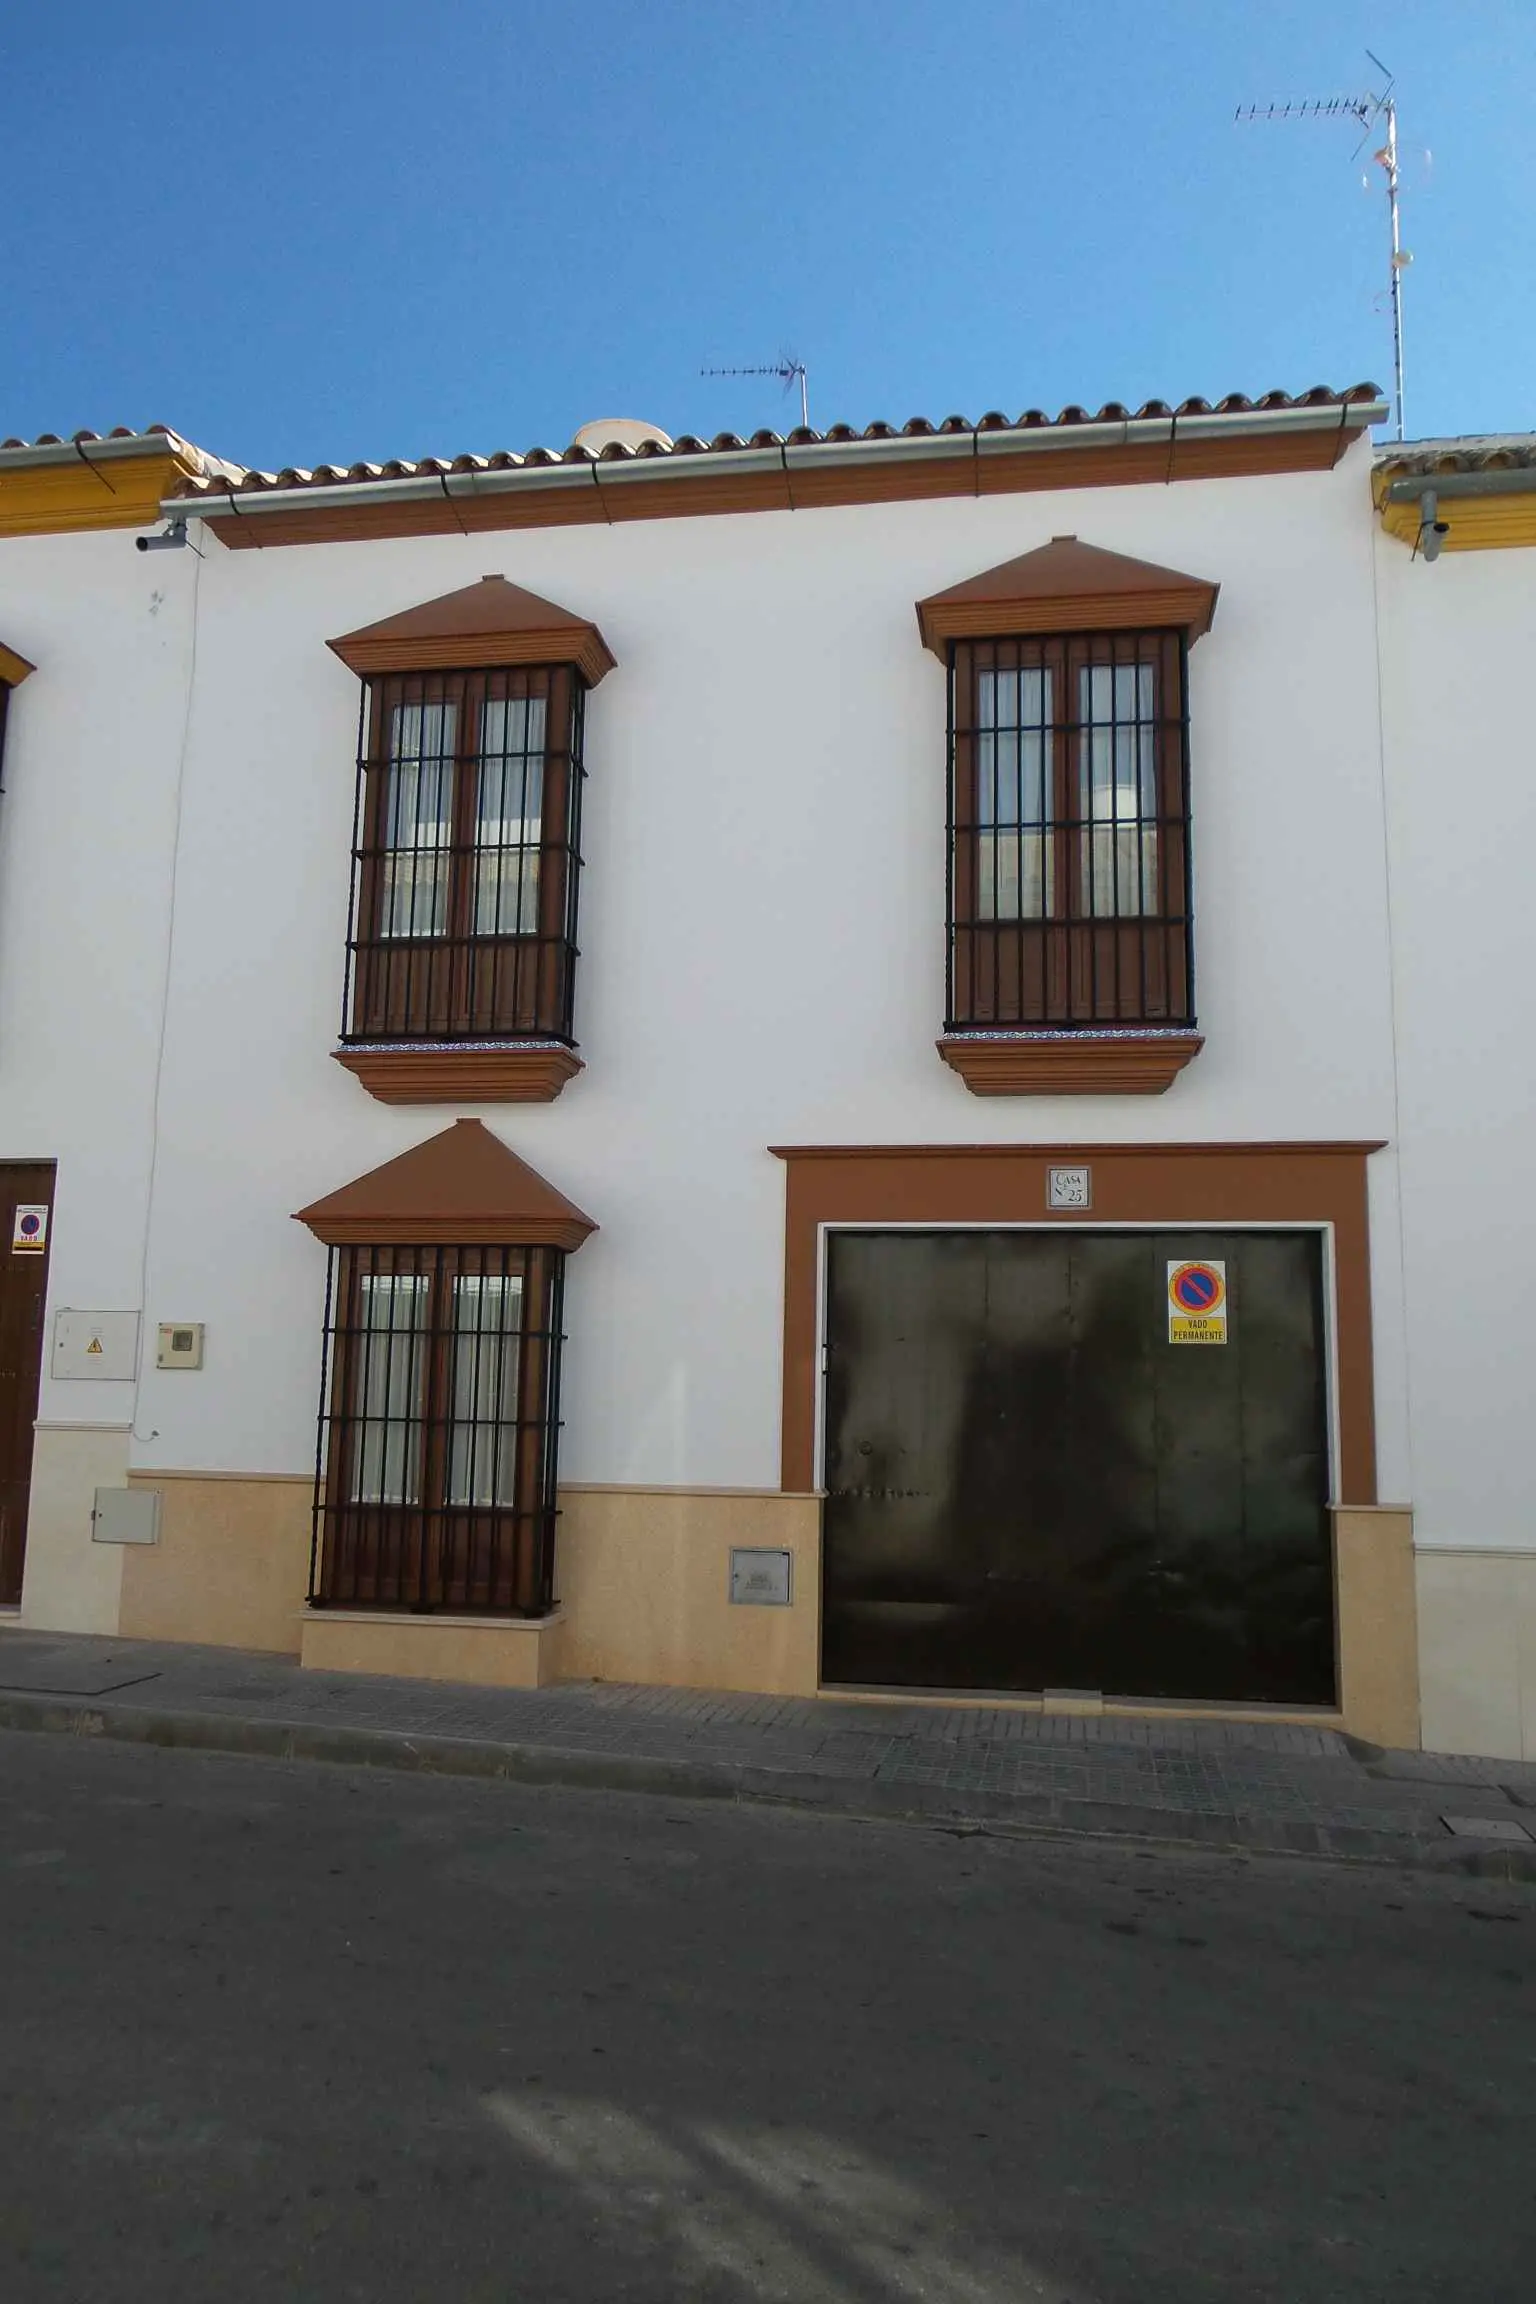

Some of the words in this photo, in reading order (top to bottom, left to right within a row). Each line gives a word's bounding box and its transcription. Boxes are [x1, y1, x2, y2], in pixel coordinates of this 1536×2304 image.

[1067, 1189, 1082, 1202] 25
[1188, 1319, 1208, 1329] VADO
[1173, 1330, 1223, 1340] PERMANENTE
